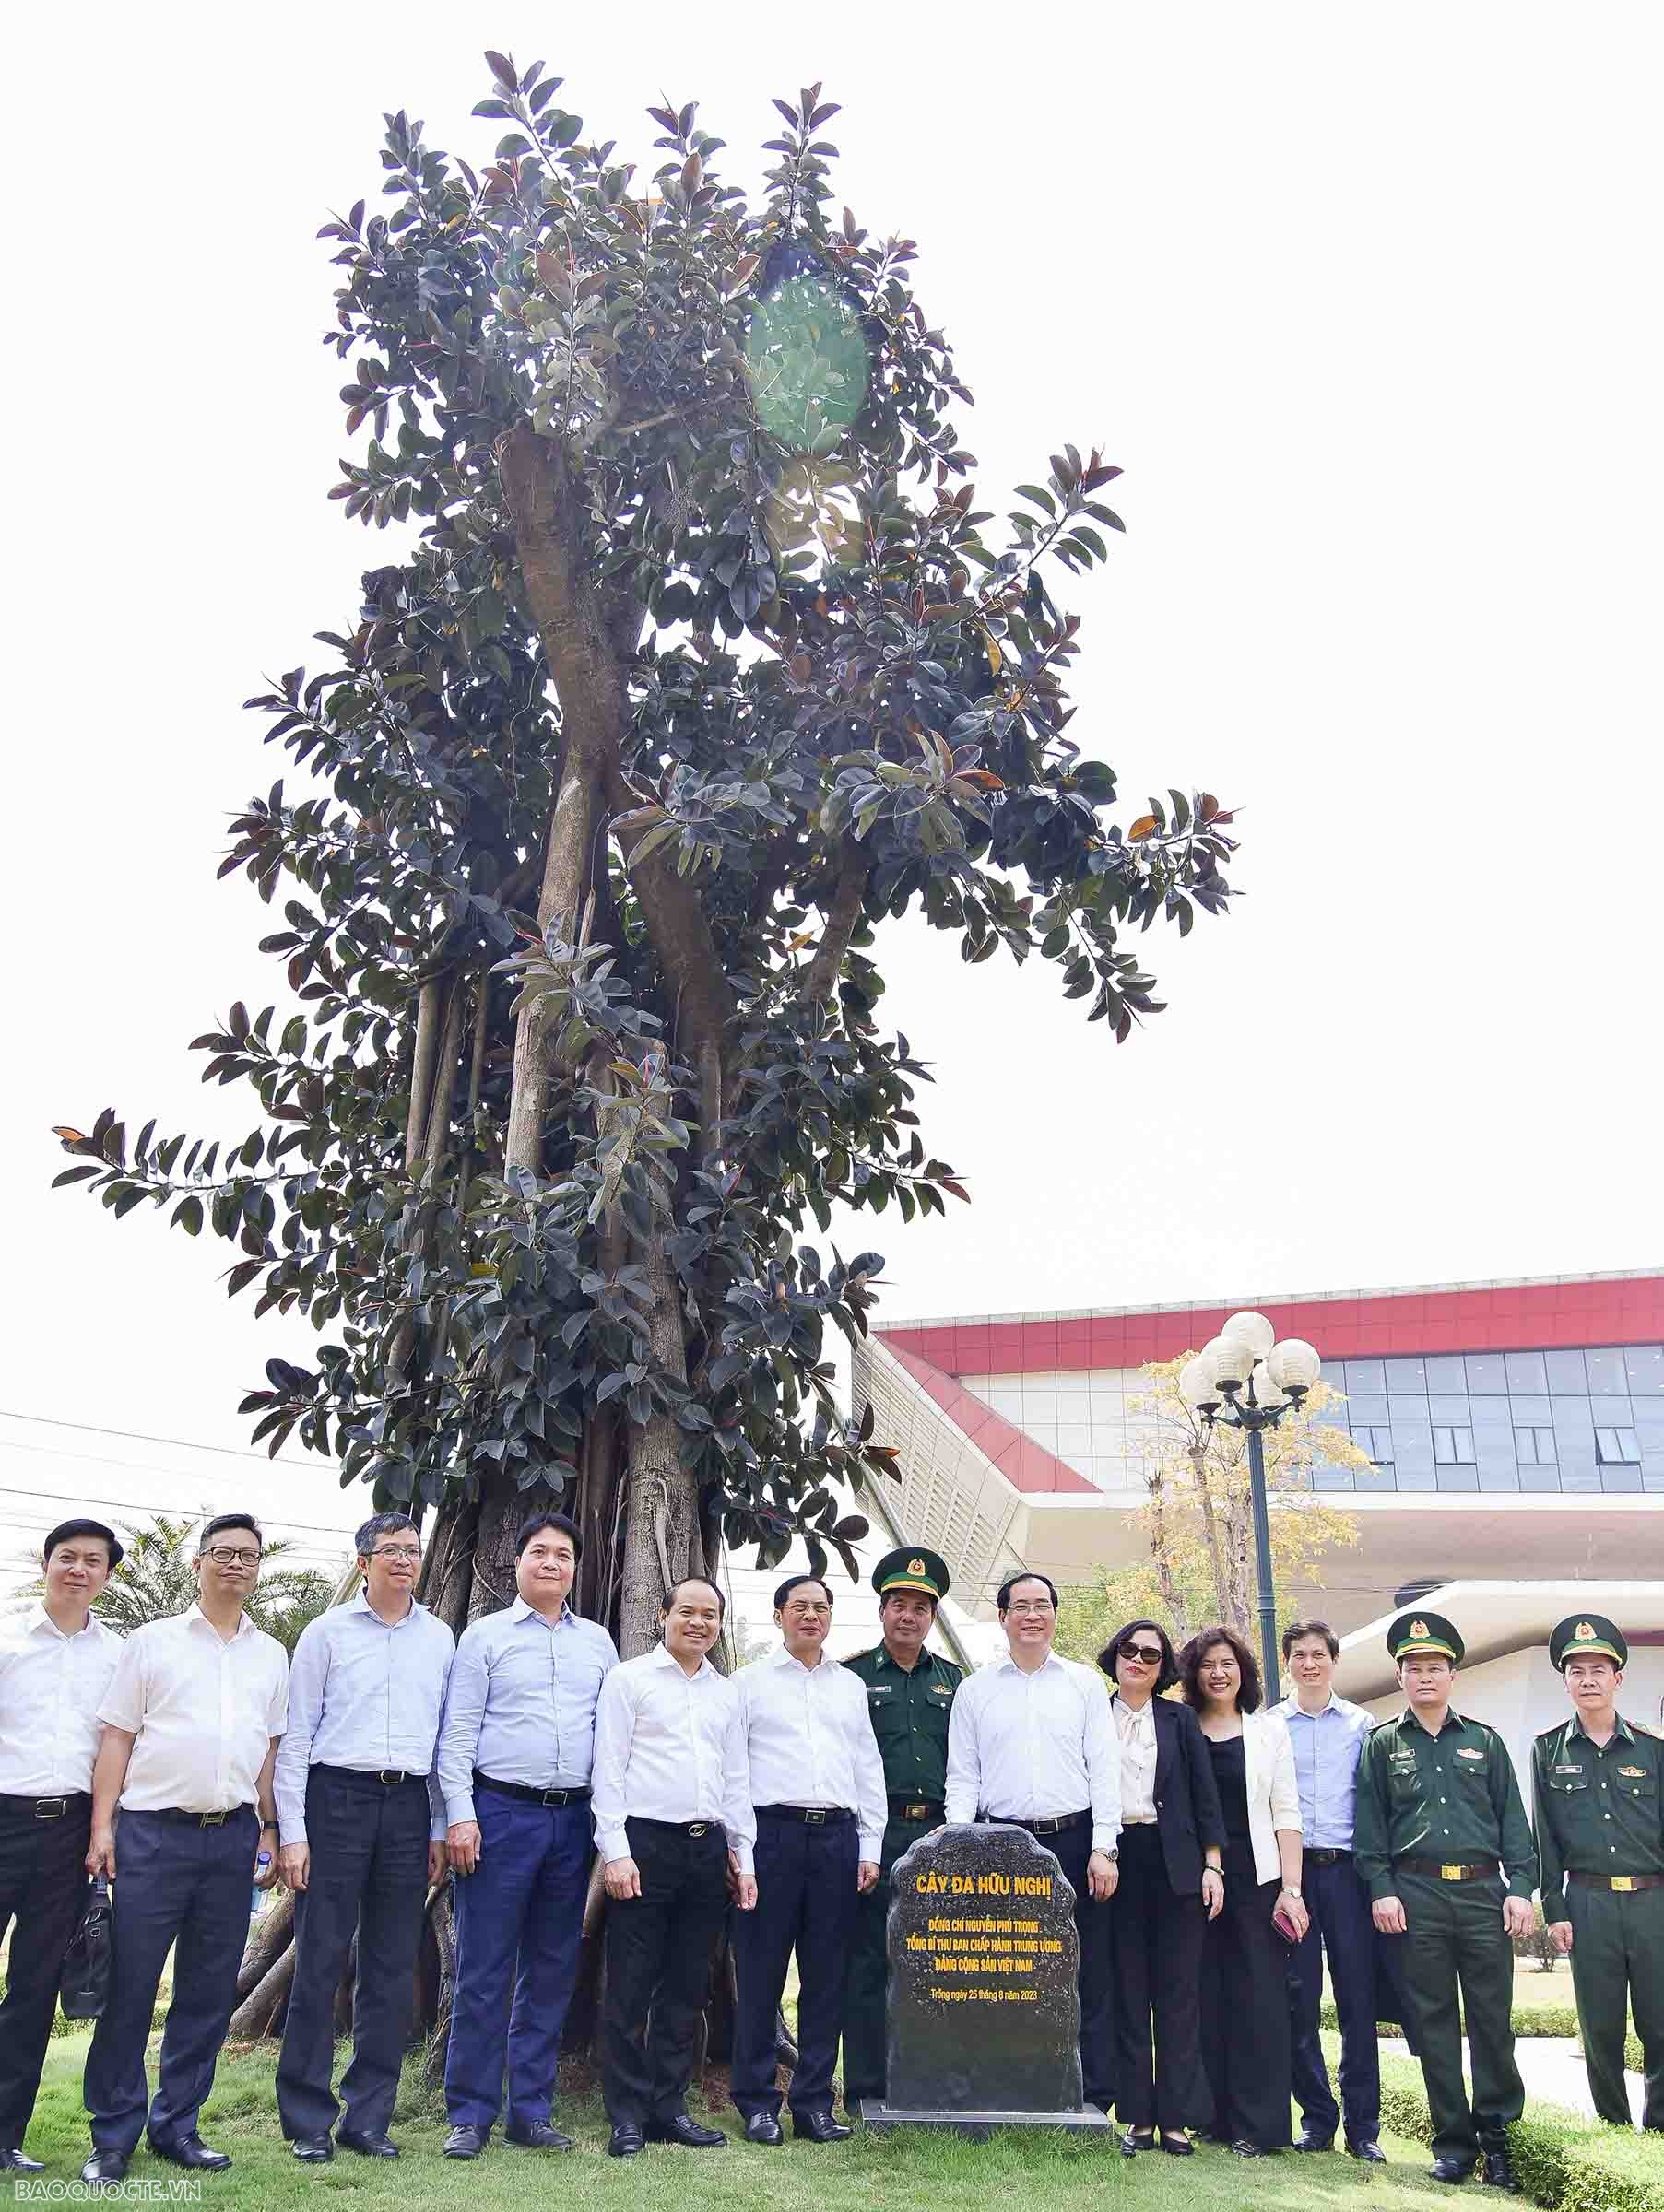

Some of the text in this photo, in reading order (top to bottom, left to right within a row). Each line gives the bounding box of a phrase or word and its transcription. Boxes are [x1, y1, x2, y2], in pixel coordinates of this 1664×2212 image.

[916, 1871, 1052, 1901] CÂY ĐA HỮU NGHỊ
[951, 1917, 964, 1932] CHÍ
[997, 1917, 1012, 1933] PHÚ
[952, 1938, 969, 1951] BAN
[991, 1937, 1012, 1952] HÀNH
[1013, 1940, 1038, 1952] TRUNG
[1015, 1959, 1033, 1972] NAM
[951, 1990, 967, 2001] ngày
[978, 1989, 997, 2002] tháng
[998, 1991, 1004, 2000] 8
[1005, 1991, 1020, 2000] năm
[1021, 1991, 1038, 2000] 2023
